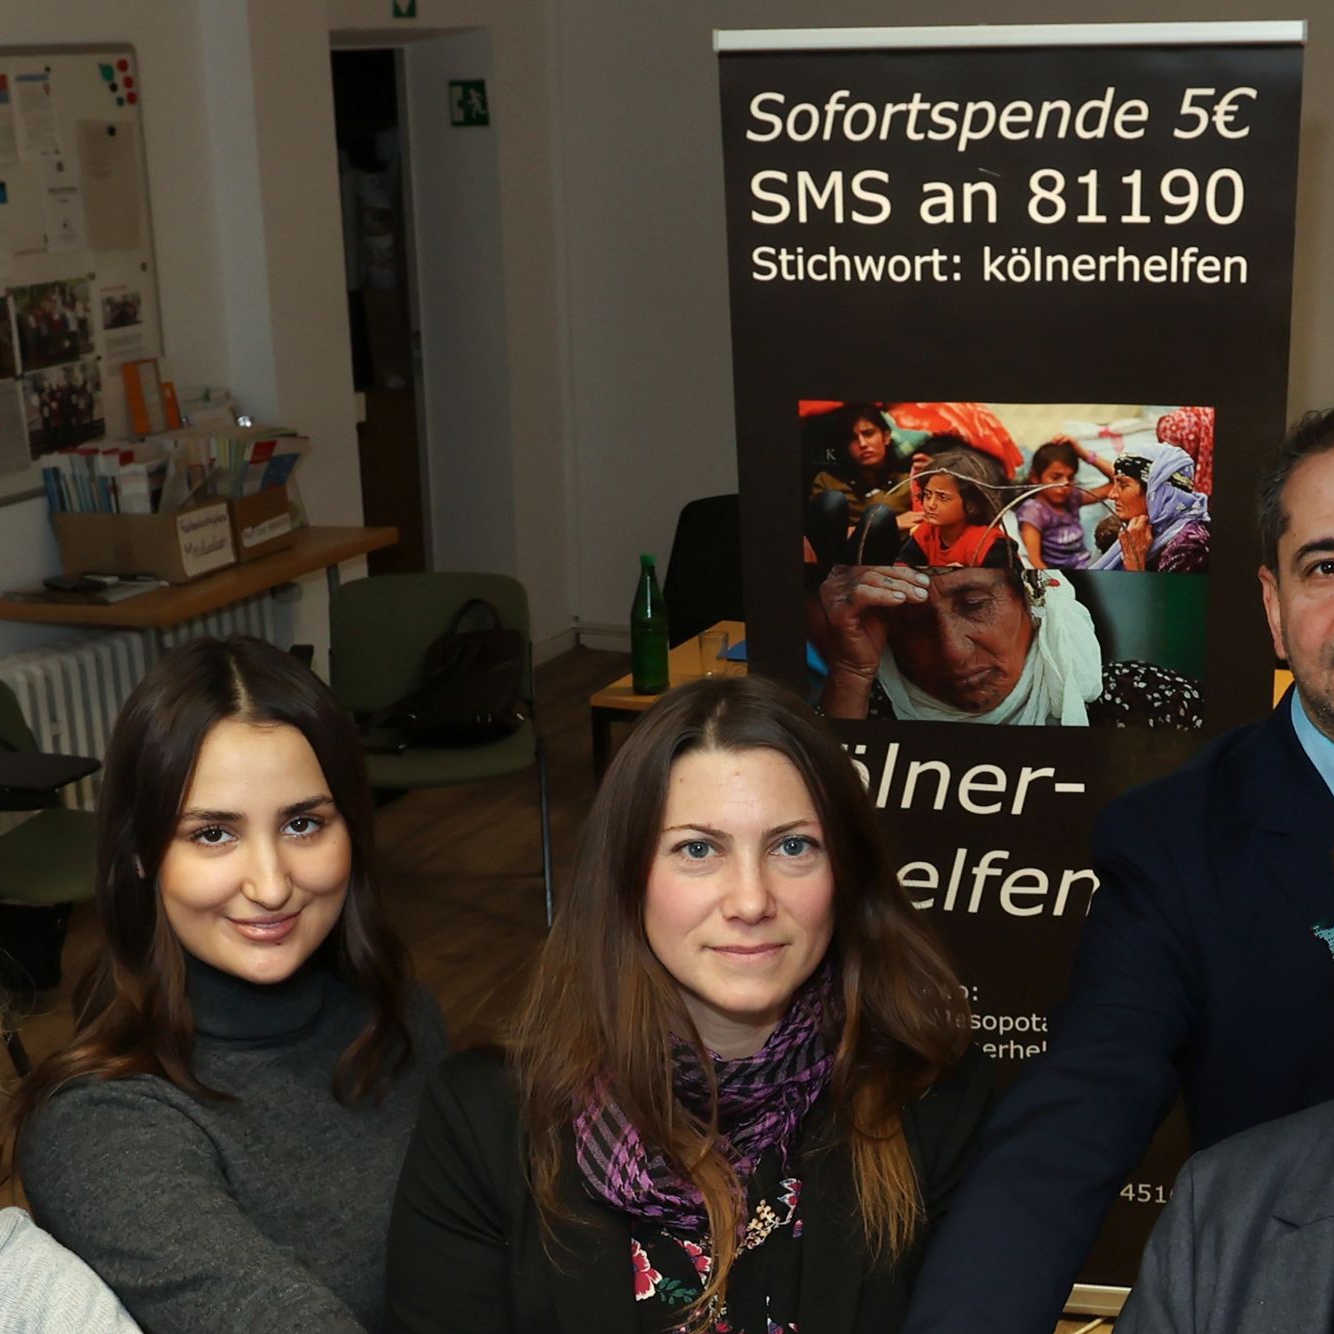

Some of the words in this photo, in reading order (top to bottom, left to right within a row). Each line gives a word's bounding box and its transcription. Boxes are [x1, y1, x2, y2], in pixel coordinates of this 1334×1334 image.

[745, 86, 1150, 152] Sofortspende
[1173, 86, 1258, 140] 5€
[750, 170, 892, 225] SMS
[919, 179, 998, 224] an
[1027, 168, 1245, 225] 81190
[752, 246, 962, 283] Stichwort:
[983, 246, 1249, 284] kölnerhelfen
[896, 847, 1101, 917] elfen
[1119, 1183, 1172, 1203] 451
